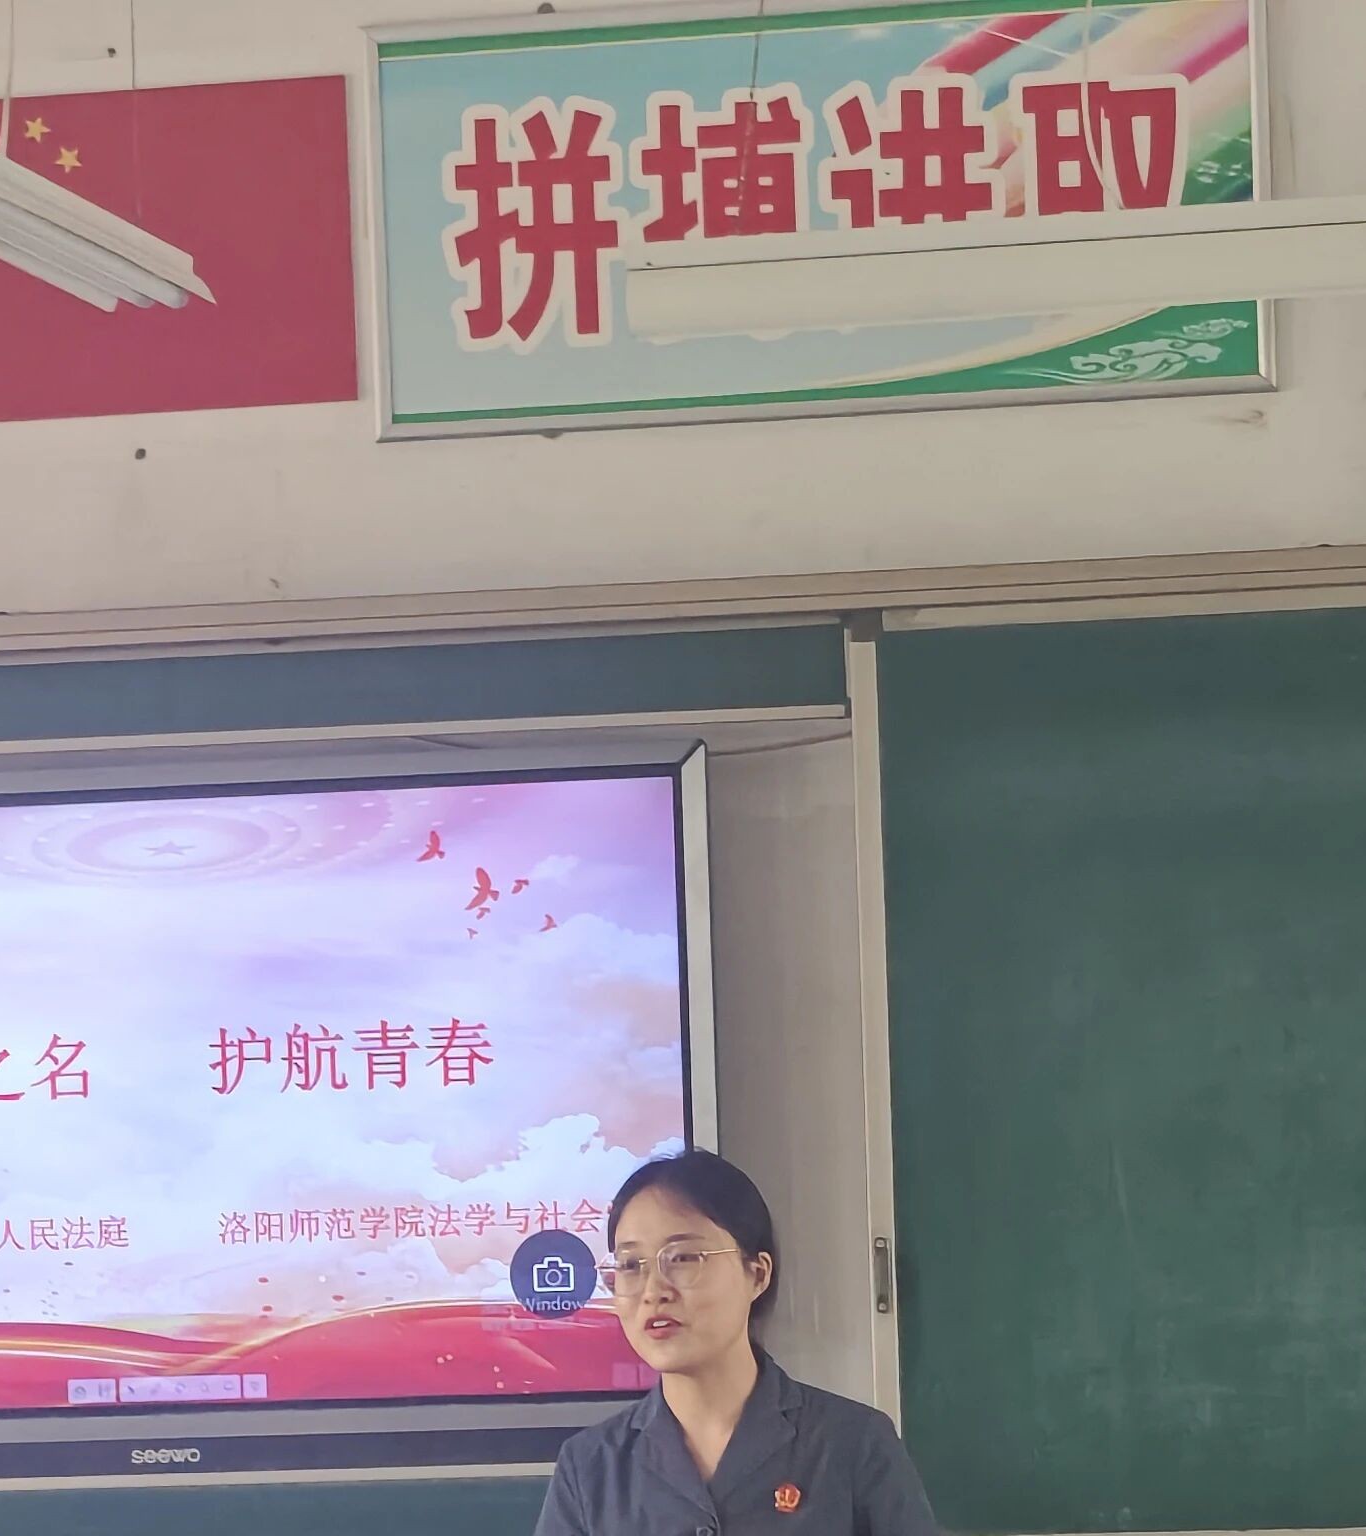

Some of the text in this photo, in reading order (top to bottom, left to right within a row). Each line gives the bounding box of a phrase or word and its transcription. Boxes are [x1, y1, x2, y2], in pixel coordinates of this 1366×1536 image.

[208, 1017, 494, 1095] 护航青春
[217, 1197, 613, 1246] 洛阳师范学院法学与社会
[131, 1447, 201, 1475] seewo
